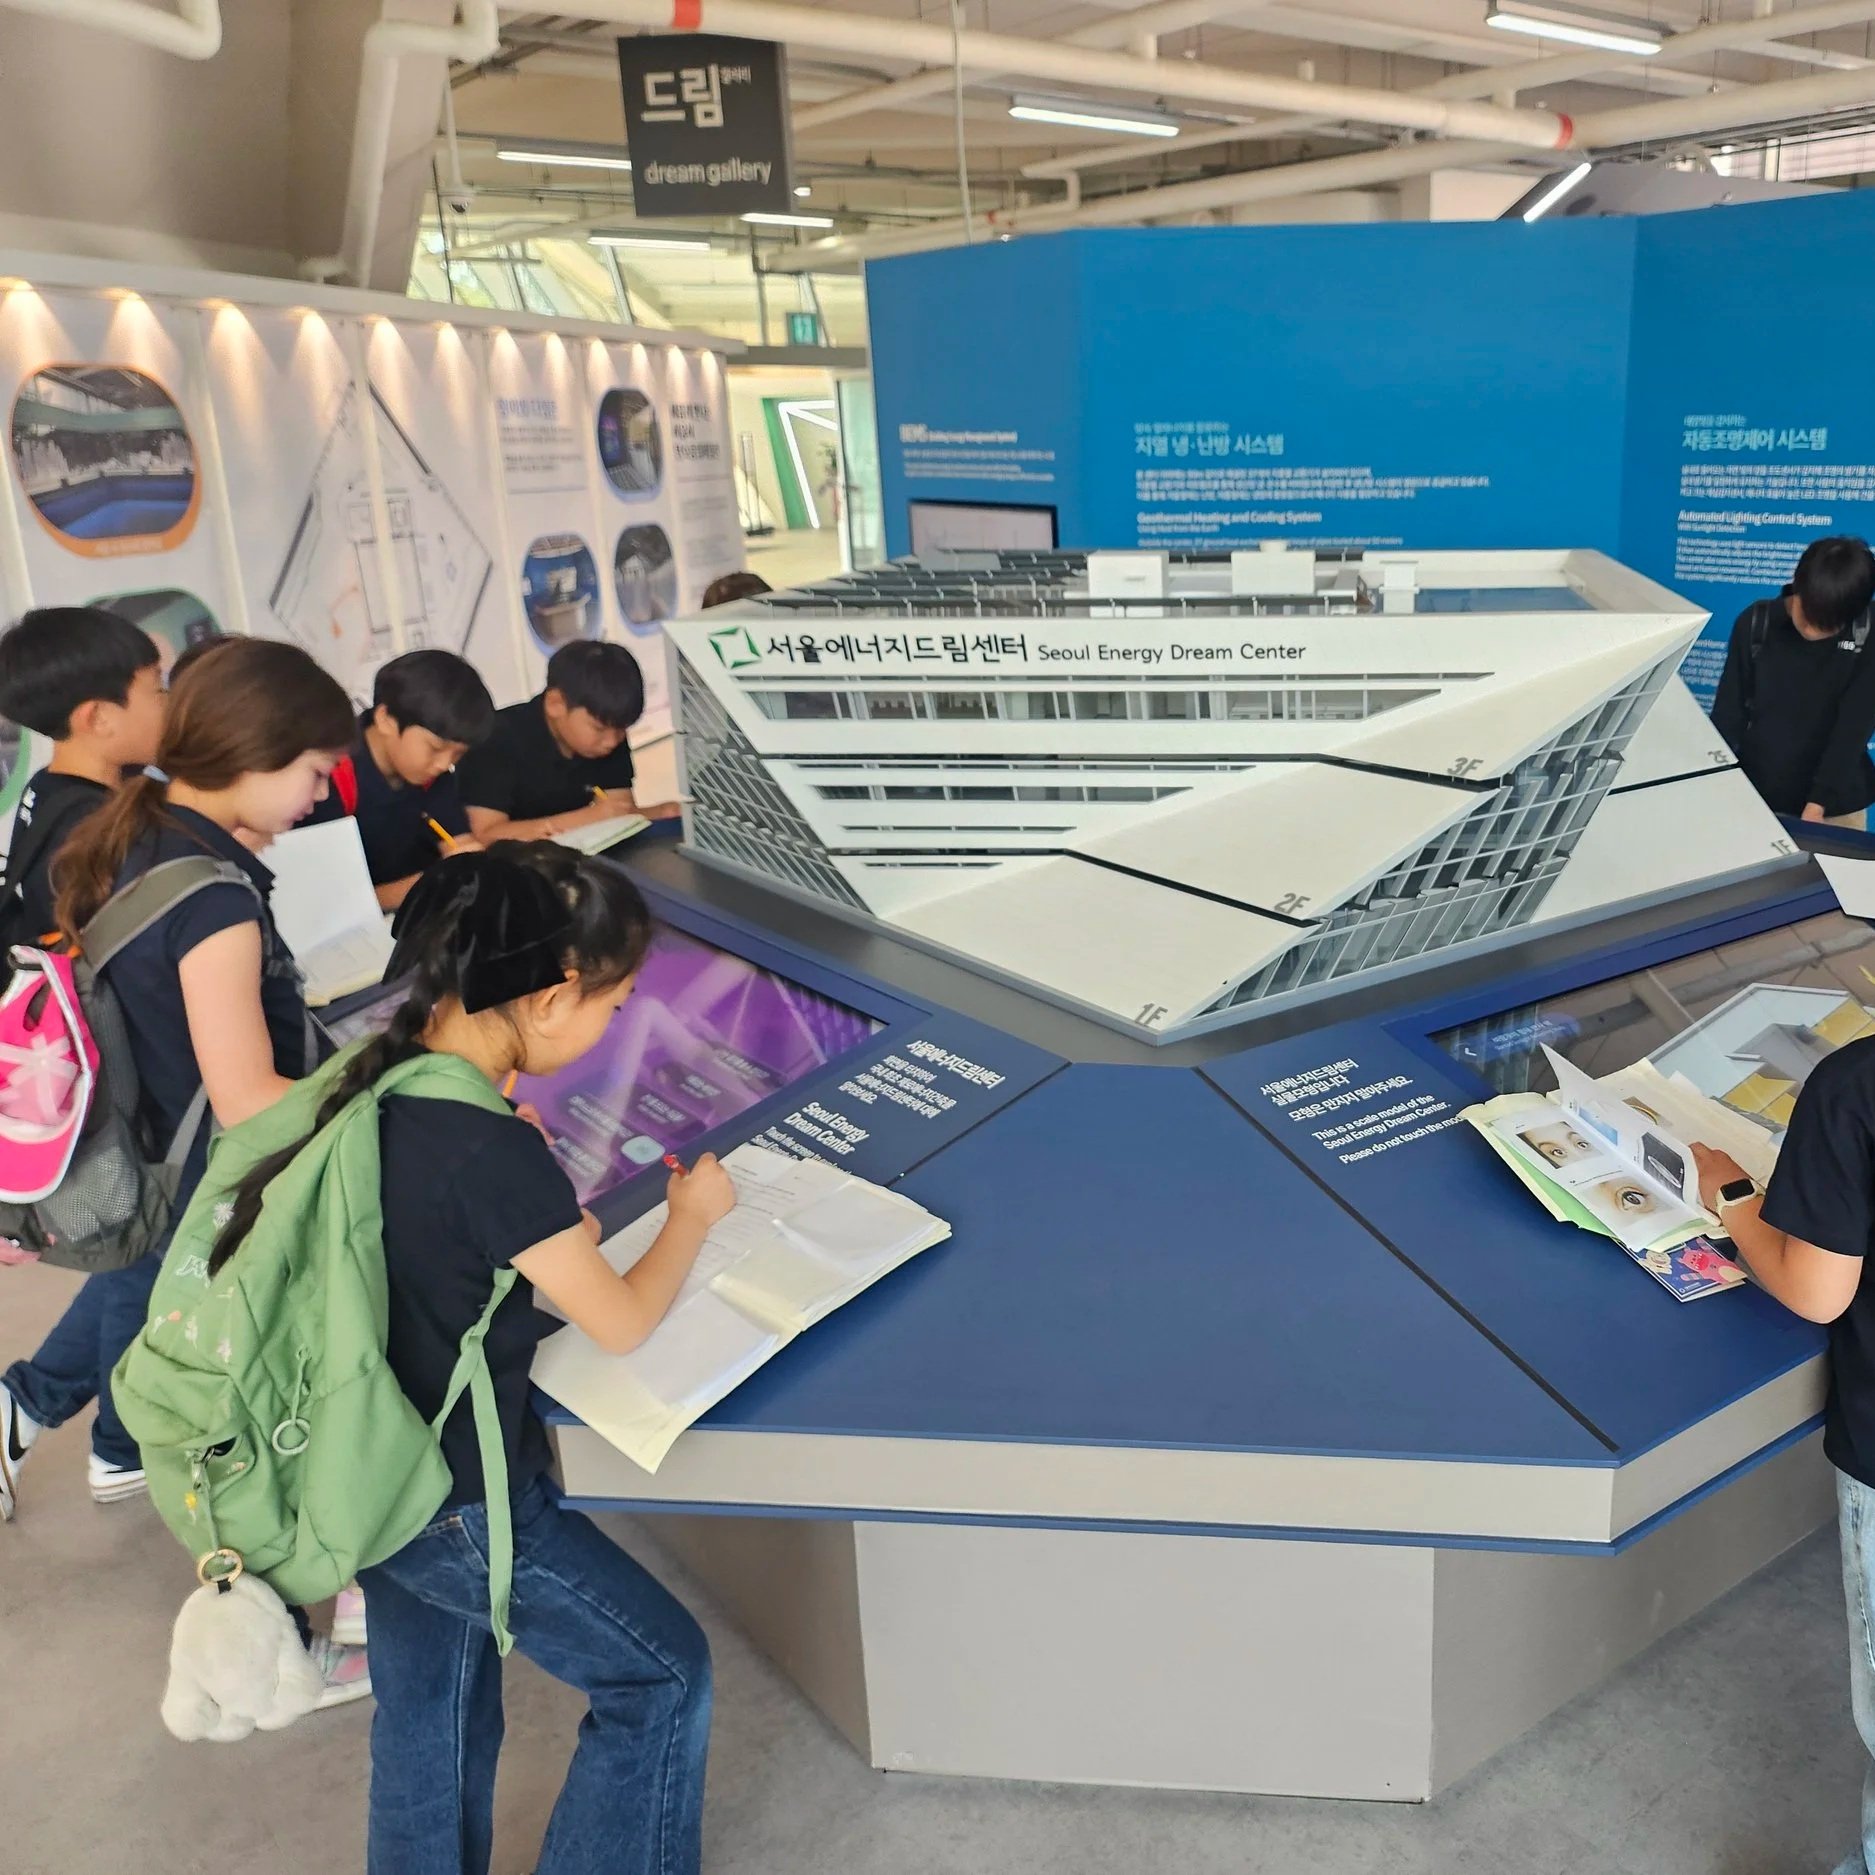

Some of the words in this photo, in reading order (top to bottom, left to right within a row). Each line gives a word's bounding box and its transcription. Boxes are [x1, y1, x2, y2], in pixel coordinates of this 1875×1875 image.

[640, 63, 724, 128] 드림
[643, 160, 705, 185] dream
[706, 157, 772, 187] gallery
[1136, 434, 1168, 457] 지열
[1234, 433, 1284, 457] 시스템
[1682, 428, 1774, 451] 자동조명제어
[1776, 427, 1827, 451] 시스템
[1678, 509, 1725, 522] Automated
[1726, 511, 1761, 526] Lighting
[1762, 512, 1794, 524] Control
[1796, 513, 1832, 527] System
[768, 633, 1028, 664] 서울에너지드림센터
[1038, 644, 1090, 661] Seoul
[1098, 644, 1164, 664] Energy
[1171, 644, 1233, 660] Dream
[1240, 643, 1306, 660] Center
[1447, 756, 1484, 777] 3F
[1707, 749, 1729, 764] 2F
[1770, 839, 1792, 855] 1F
[1273, 892, 1310, 915] 2F
[1135, 1002, 1168, 1027] 1F
[906, 1040, 1006, 1090] 서울에너지드림센터
[1260, 1058, 1359, 1095] 서울에너지드림센터
[1272, 1074, 1350, 1107] 실물모형입니다
[1288, 1103, 1327, 1122] 모형은
[1321, 1091, 1360, 1111] 만지지
[1311, 1129, 1337, 1141] This
[1335, 1125, 1348, 1134] is
[1345, 1122, 1355, 1130] a
[1354, 1113, 1380, 1127] scale
[1377, 1104, 1410, 1119] model
[1406, 1099, 1419, 1109] of
[1416, 1095, 1435, 1105] the
[783, 1112, 822, 1138] Dream
[816, 1130, 855, 1155] Center
[802, 1102, 839, 1124] Seoul
[828, 1115, 870, 1143] Energy
[1322, 1135, 1353, 1150] Seoul
[1351, 1122, 1388, 1141] Energy
[1386, 1113, 1419, 1128] Dream
[1415, 1101, 1452, 1117] Center.
[1339, 1147, 1374, 1164] Please
[1372, 1142, 1388, 1153] do
[1384, 1136, 1404, 1149] not
[1401, 1128, 1430, 1142] touch
[1424, 1122, 1445, 1134] the
